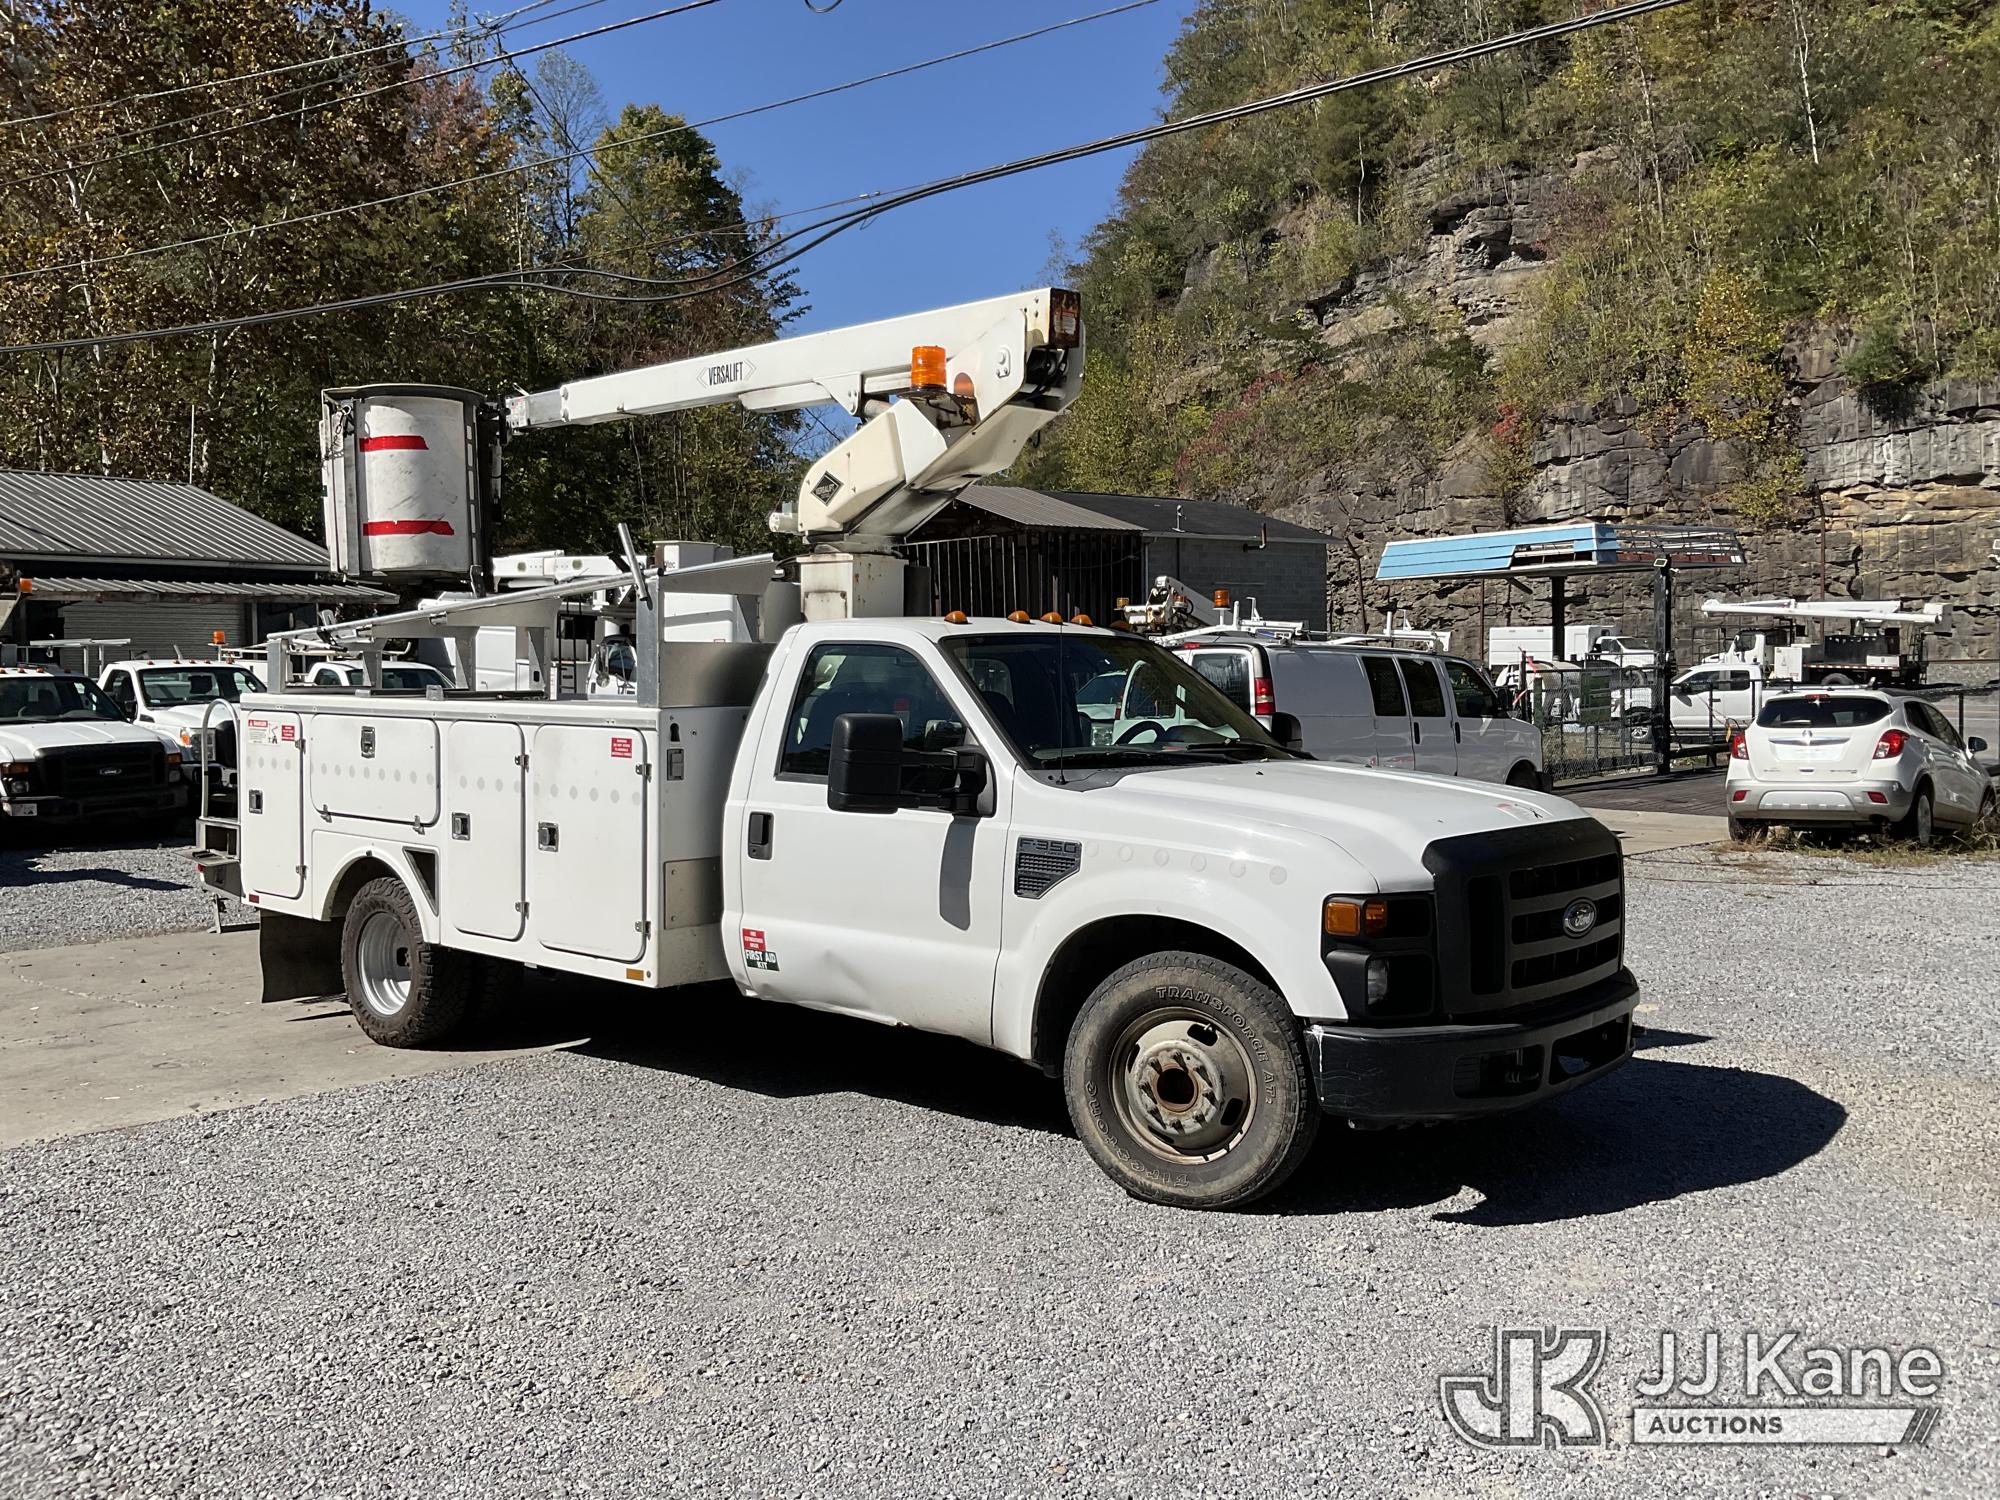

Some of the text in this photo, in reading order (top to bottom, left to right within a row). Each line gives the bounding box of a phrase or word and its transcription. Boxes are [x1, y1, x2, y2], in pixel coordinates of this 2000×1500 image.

[708, 361, 744, 386] VERSALIFT
[1020, 838, 1077, 853] F-350
[746, 950, 776, 963] FIRST AID
[757, 961, 767, 969] KIT
[1155, 986, 1269, 1062] TRANSFORCE
